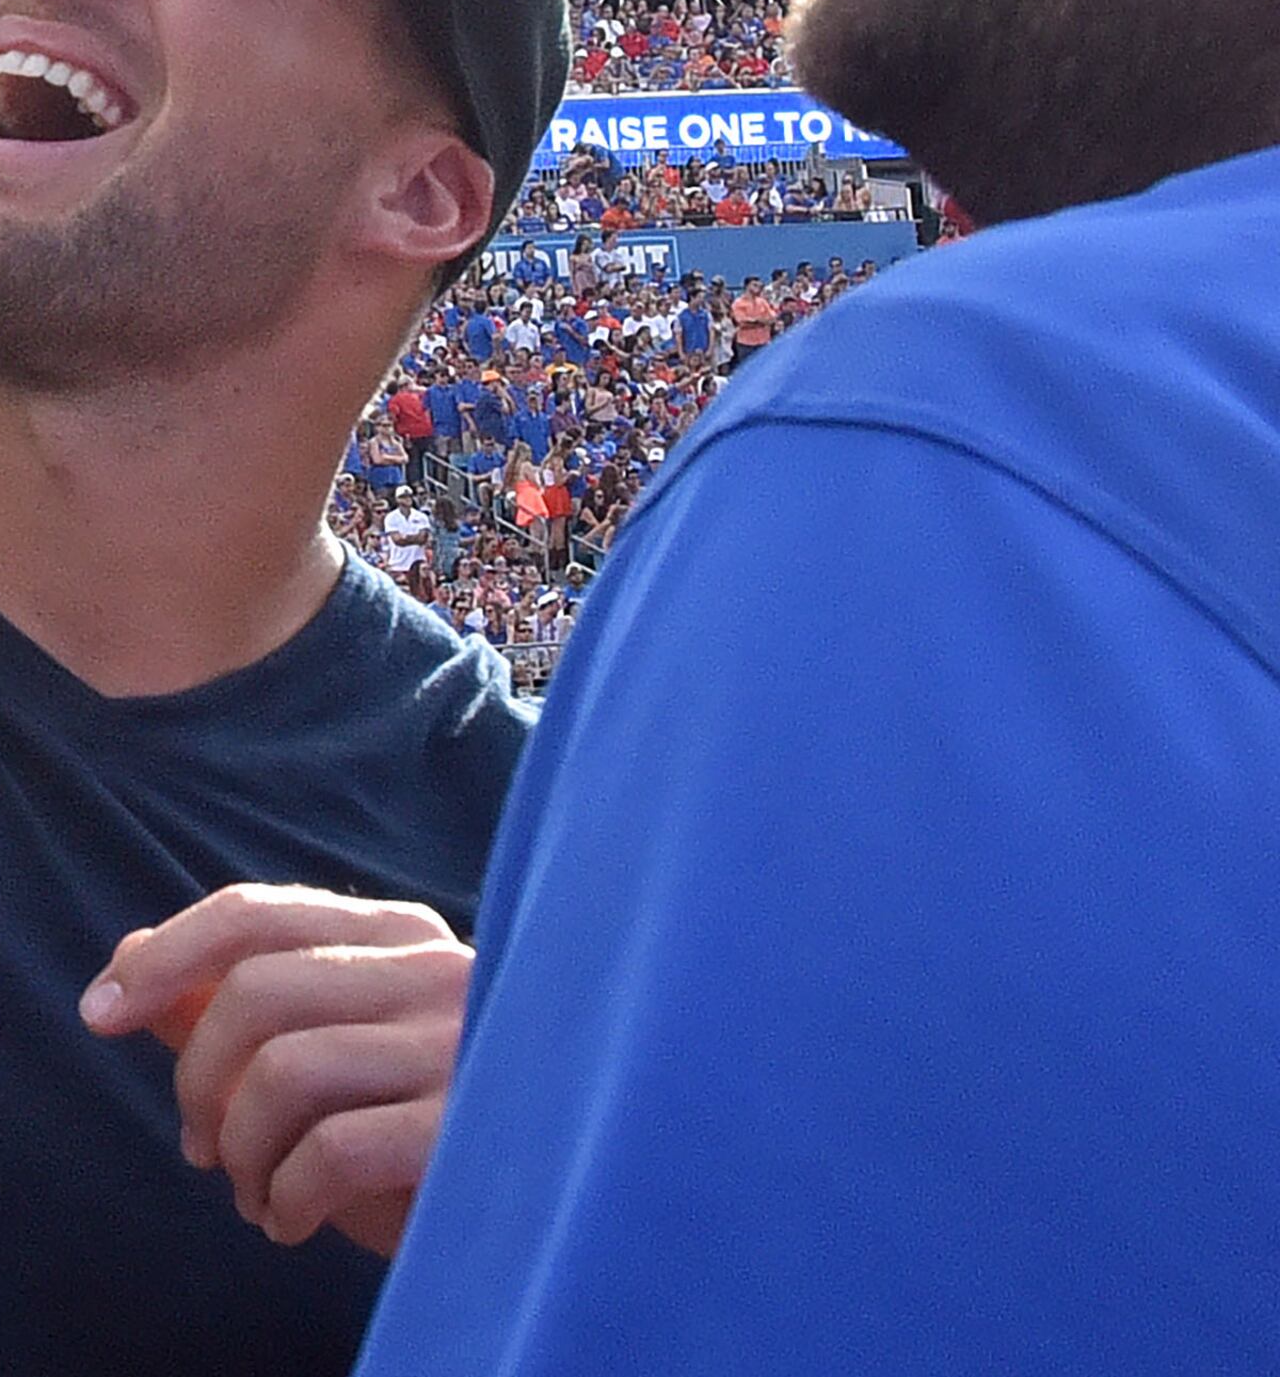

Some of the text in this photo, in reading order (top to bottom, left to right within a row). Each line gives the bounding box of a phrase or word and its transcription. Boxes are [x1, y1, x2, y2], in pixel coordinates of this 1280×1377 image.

[550, 114, 669, 152] RAISE
[678, 112, 767, 150] ONE
[774, 110, 833, 143] TO
